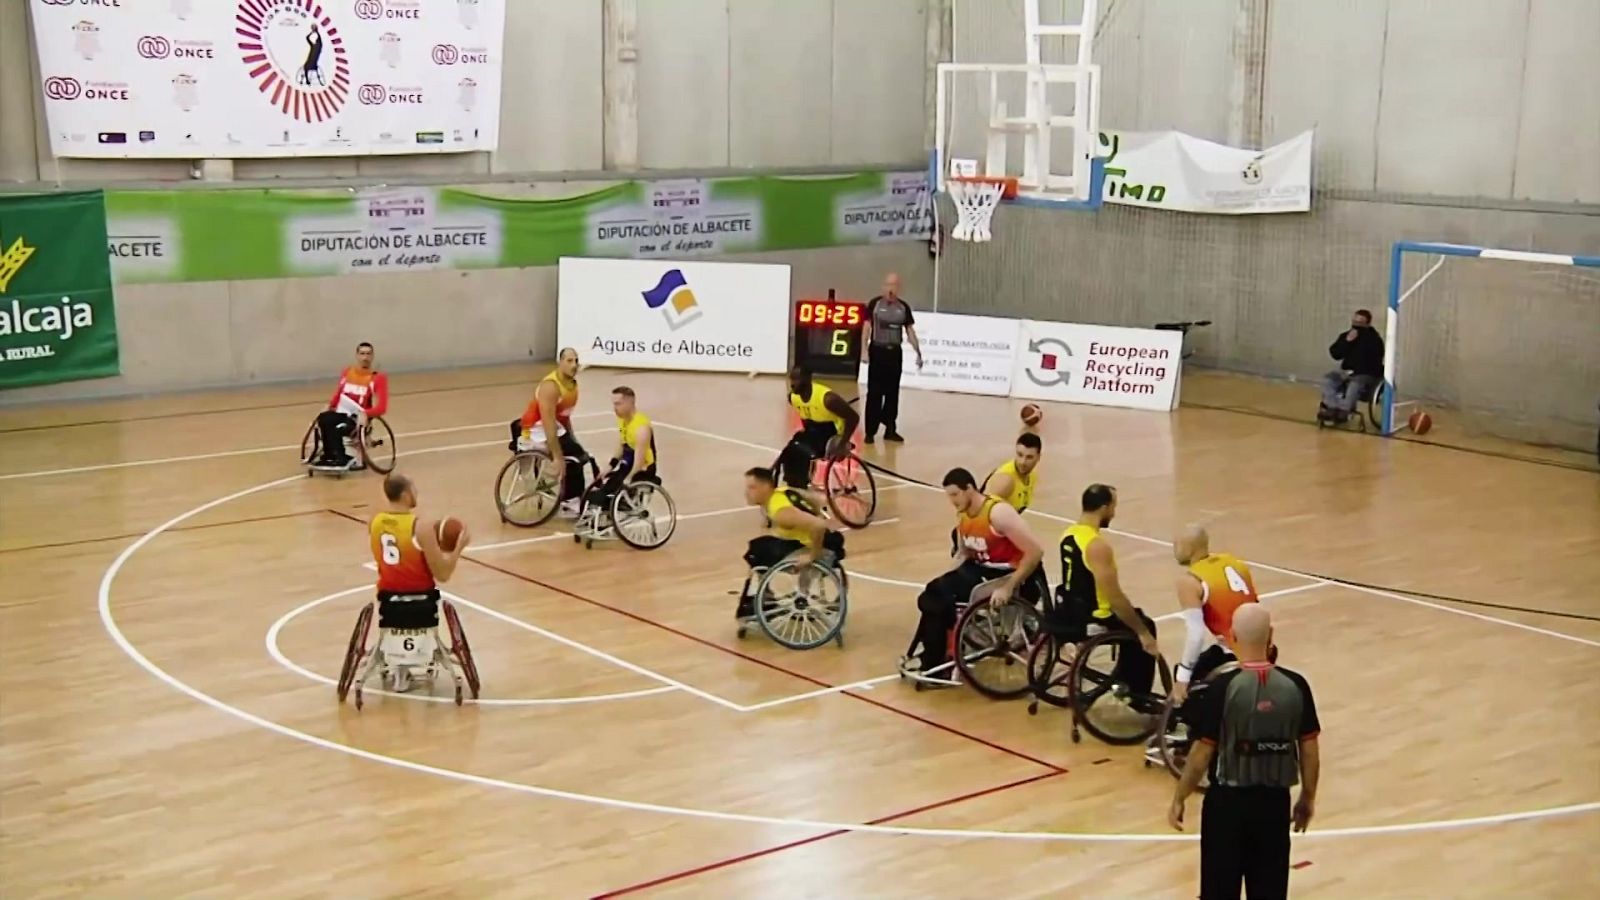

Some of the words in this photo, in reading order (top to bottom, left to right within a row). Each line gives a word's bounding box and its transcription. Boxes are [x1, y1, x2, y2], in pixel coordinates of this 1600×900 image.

[386, 9, 420, 19] ONCE
[174, 48, 214, 59] ONCE
[461, 54, 488, 63] ONCE
[85, 89, 129, 100] ONCE
[389, 94, 423, 104] ONCE
[907, 208, 921, 220] DE
[598, 222, 670, 240] DIPUTACIÓN
[673, 223, 689, 235] DE
[692, 219, 751, 234] ALBACETE
[301, 234, 389, 252] DIPUTACIÓN
[393, 236, 411, 248] DE
[416, 232, 487, 247] ALBACETE
[675, 239, 714, 252] deporte
[351, 258, 372, 267] con
[378, 254, 390, 265] el
[395, 254, 441, 267] deporte
[0, 296, 92, 340] alcaja
[800, 304, 860, 325] 09:25
[592, 336, 646, 355] Aguas
[651, 339, 673, 354] de
[677, 340, 753, 357] Albacete
[831, 329, 849, 355] 6
[6, 344, 55, 360] RURAL
[1089, 342, 1169, 361] European
[1085, 359, 1166, 381] Recycling
[1083, 376, 1154, 394] Platform
[380, 532, 401, 565] 6
[1224, 565, 1251, 596] 4
[403, 637, 415, 652] 6
